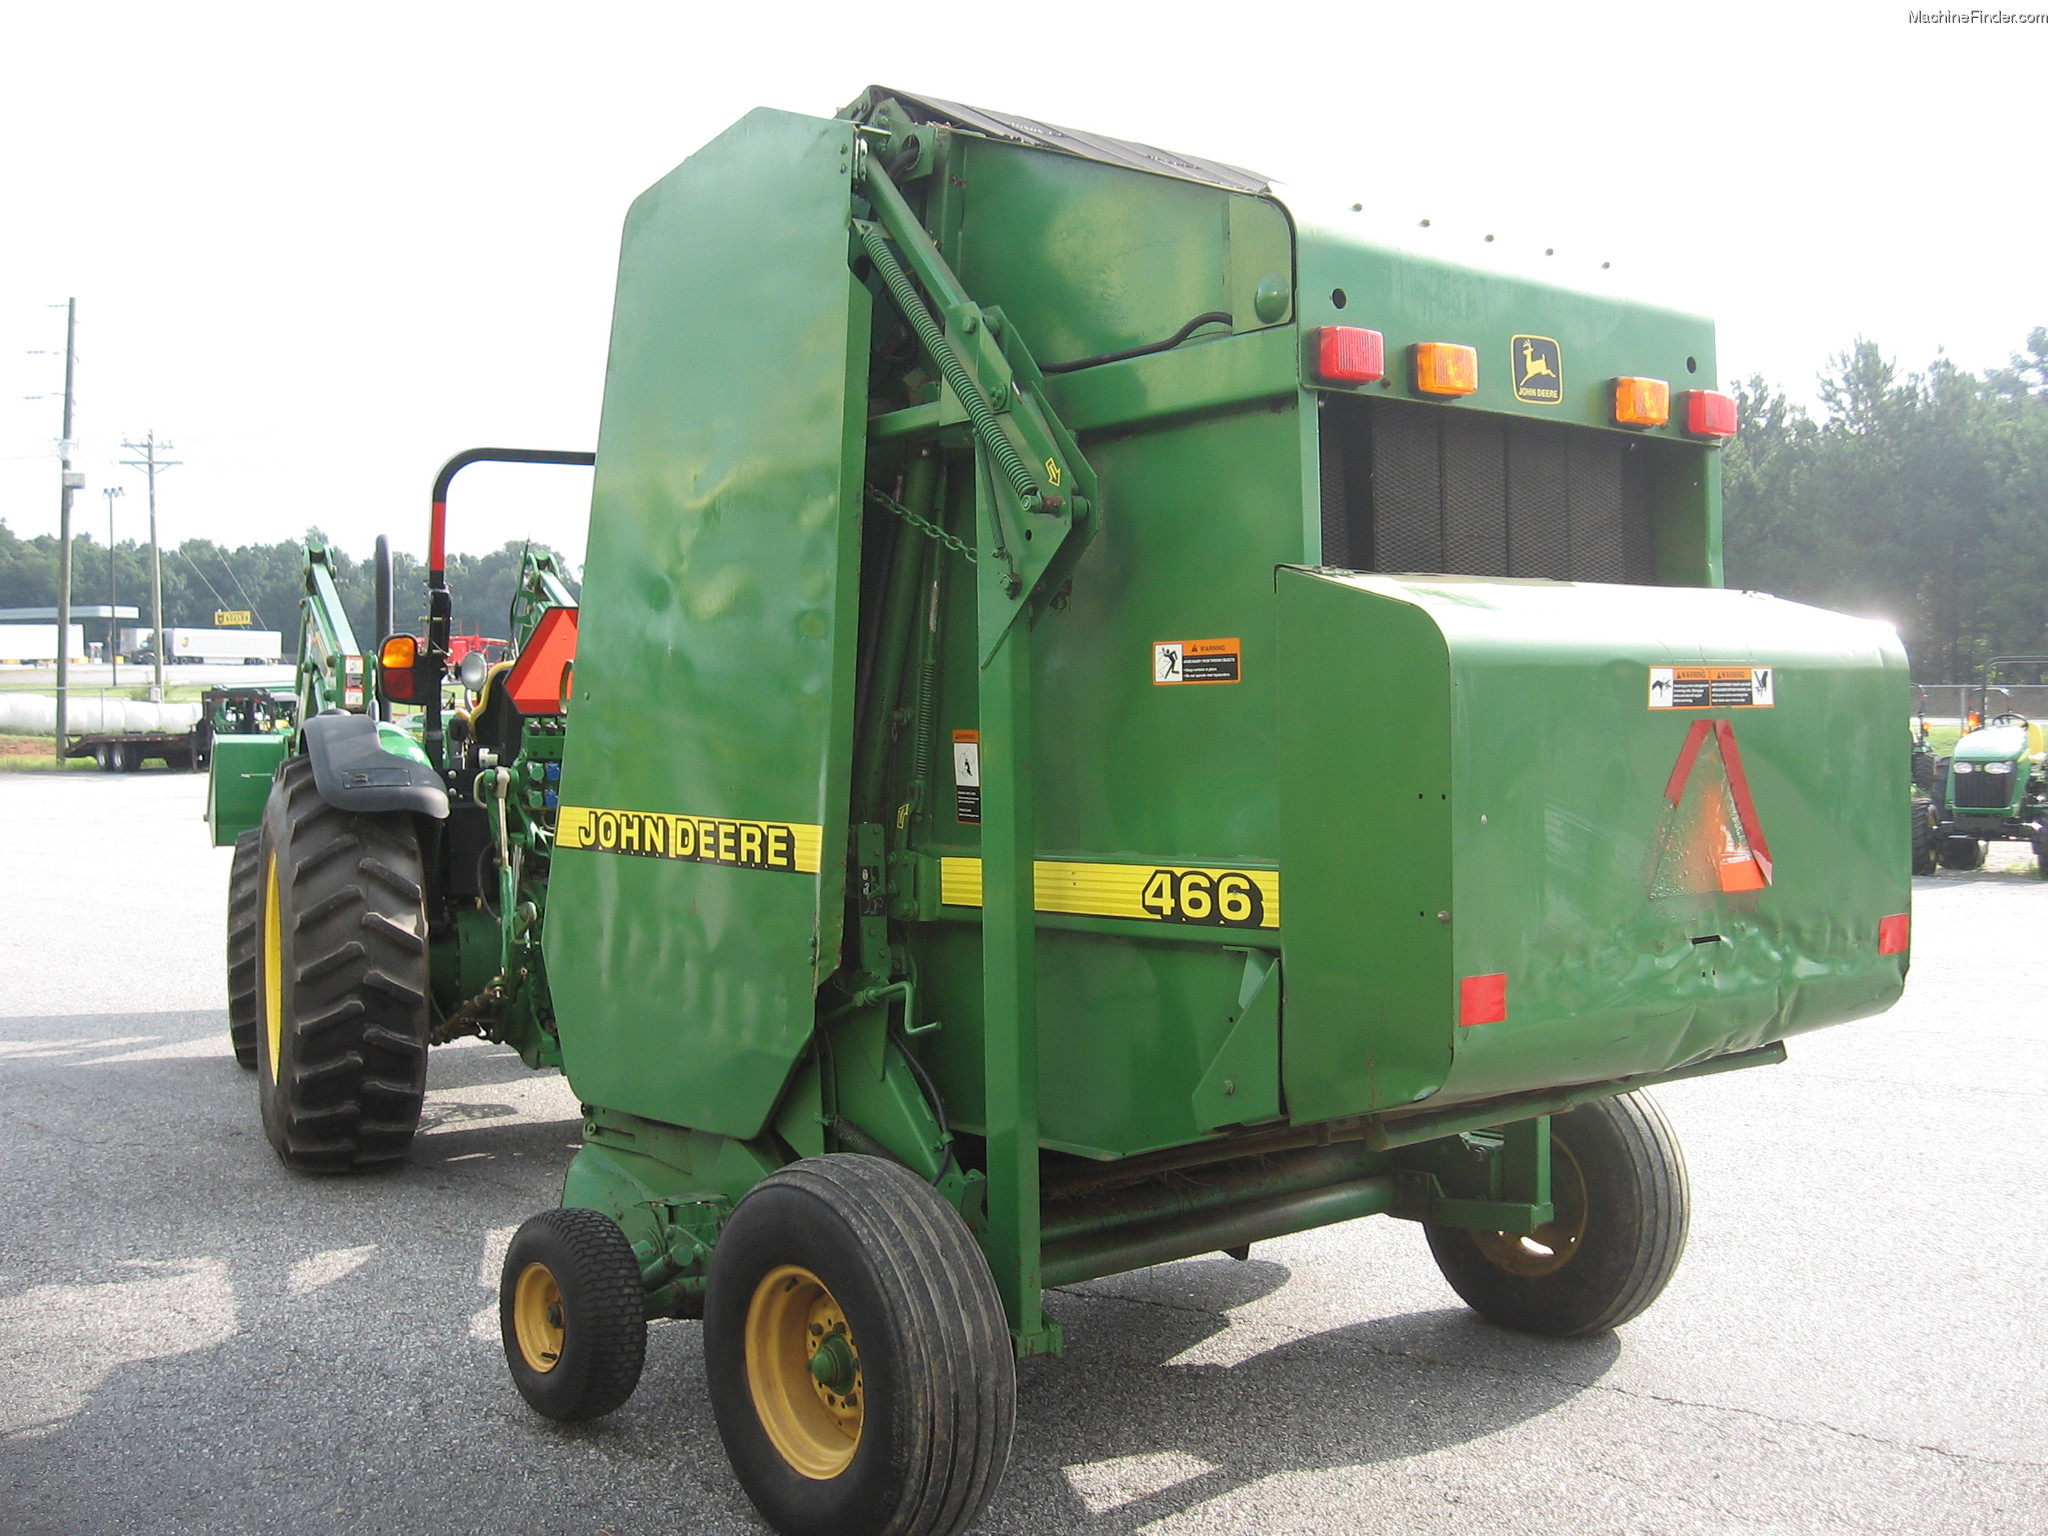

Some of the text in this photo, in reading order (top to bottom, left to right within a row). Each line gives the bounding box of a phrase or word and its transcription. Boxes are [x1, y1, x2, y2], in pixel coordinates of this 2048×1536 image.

[1518, 387, 1558, 398] JOHN DEERE
[578, 812, 790, 867] JOHN DEERE
[1143, 871, 1254, 922] 466
